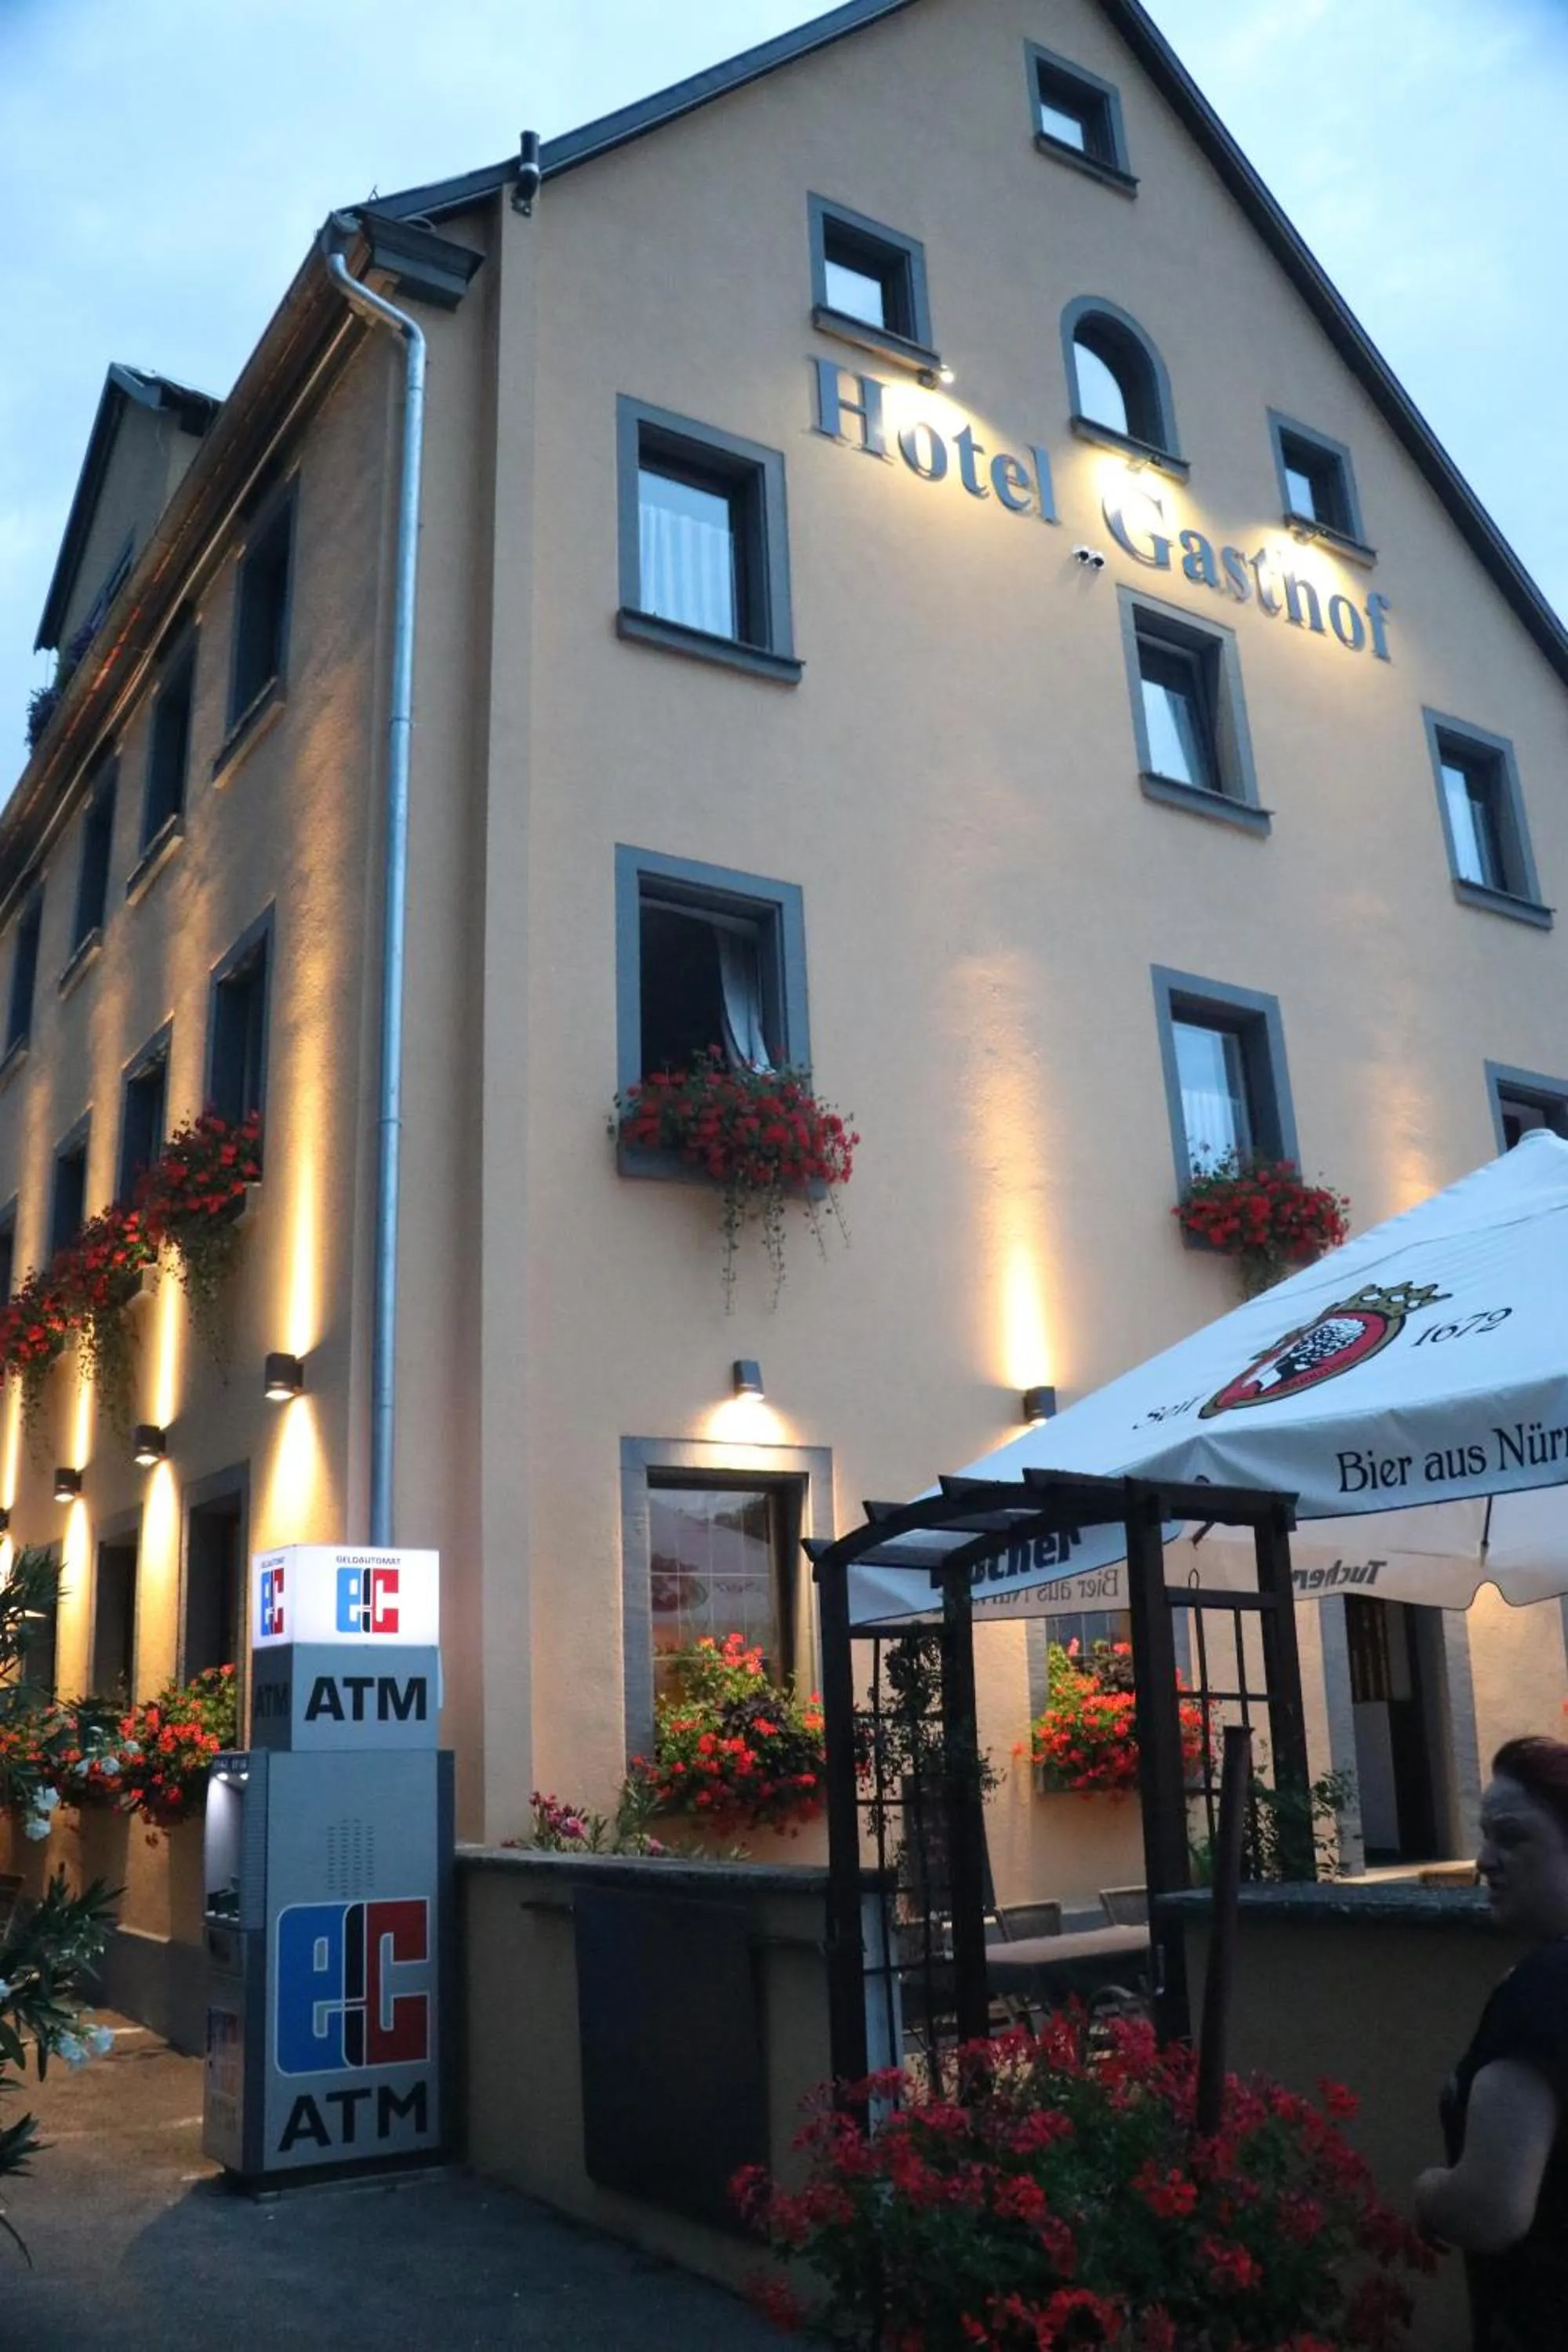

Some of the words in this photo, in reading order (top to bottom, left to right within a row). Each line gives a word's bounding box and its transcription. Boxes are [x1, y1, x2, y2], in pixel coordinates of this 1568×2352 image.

[814, 358, 1058, 525] Hotel
[1102, 488, 1392, 663] Gasthof
[1411, 1307, 1513, 1347] 1672
[1335, 1450, 1413, 1492] Bier
[1424, 1445, 1487, 1482] aus
[1492, 1422, 1568, 1471] Nür
[256, 1682, 289, 1719] ATM
[303, 1676, 427, 1721] ATM
[277, 2080, 428, 2153] ATM
